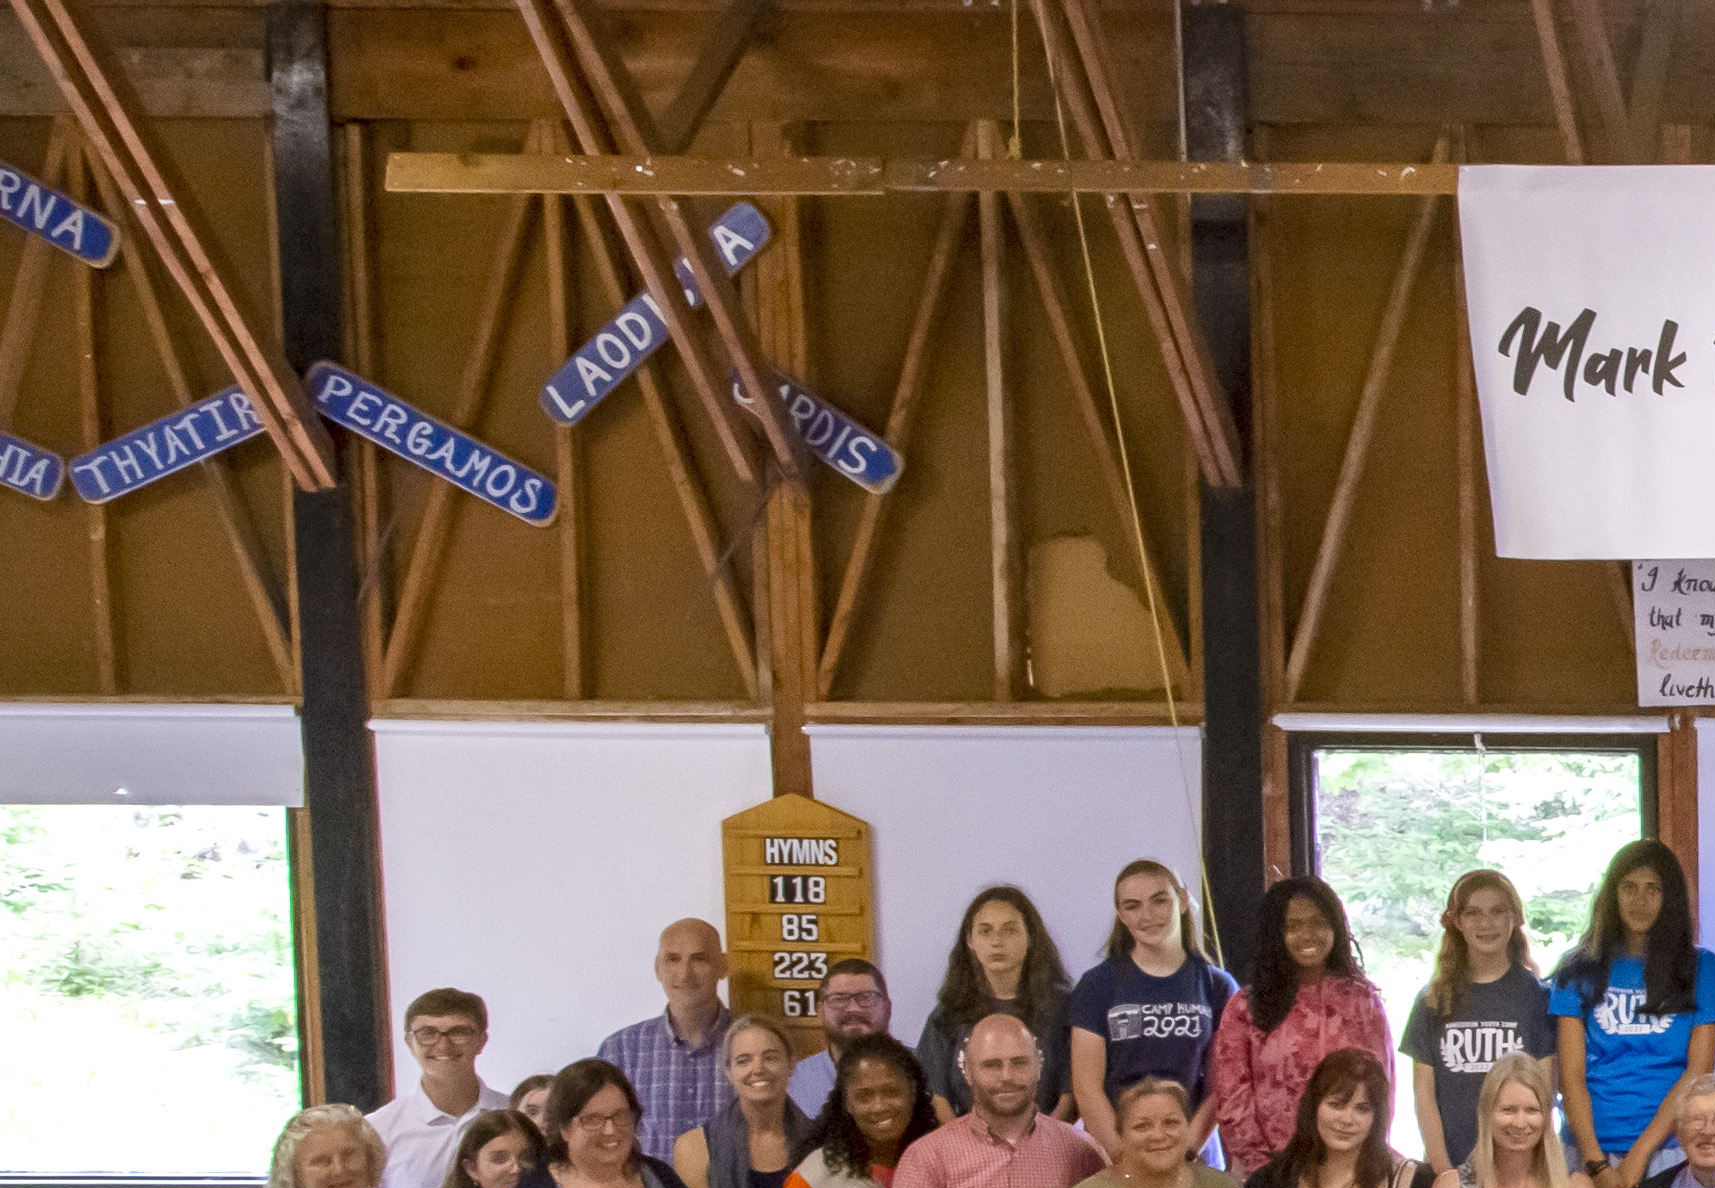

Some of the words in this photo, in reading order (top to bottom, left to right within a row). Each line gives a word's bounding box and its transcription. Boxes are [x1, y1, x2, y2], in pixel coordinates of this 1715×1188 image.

[545, 225, 754, 420] LAODIA
[1498, 306, 1687, 403] Mark
[733, 383, 877, 474] RDIS
[73, 392, 264, 494] THYATIR
[317, 375, 543, 514] PERGAMOS
[1650, 606, 1682, 630] that
[765, 838, 838, 865] HYMNS
[772, 876, 825, 904] 118
[781, 914, 819, 941] 85
[773, 952, 828, 979] 223
[783, 990, 817, 1017] 61
[1140, 1003, 1174, 1015] CAMP
[1143, 1015, 1202, 1038] 2021
[1446, 1027, 1515, 1063] RUTH
